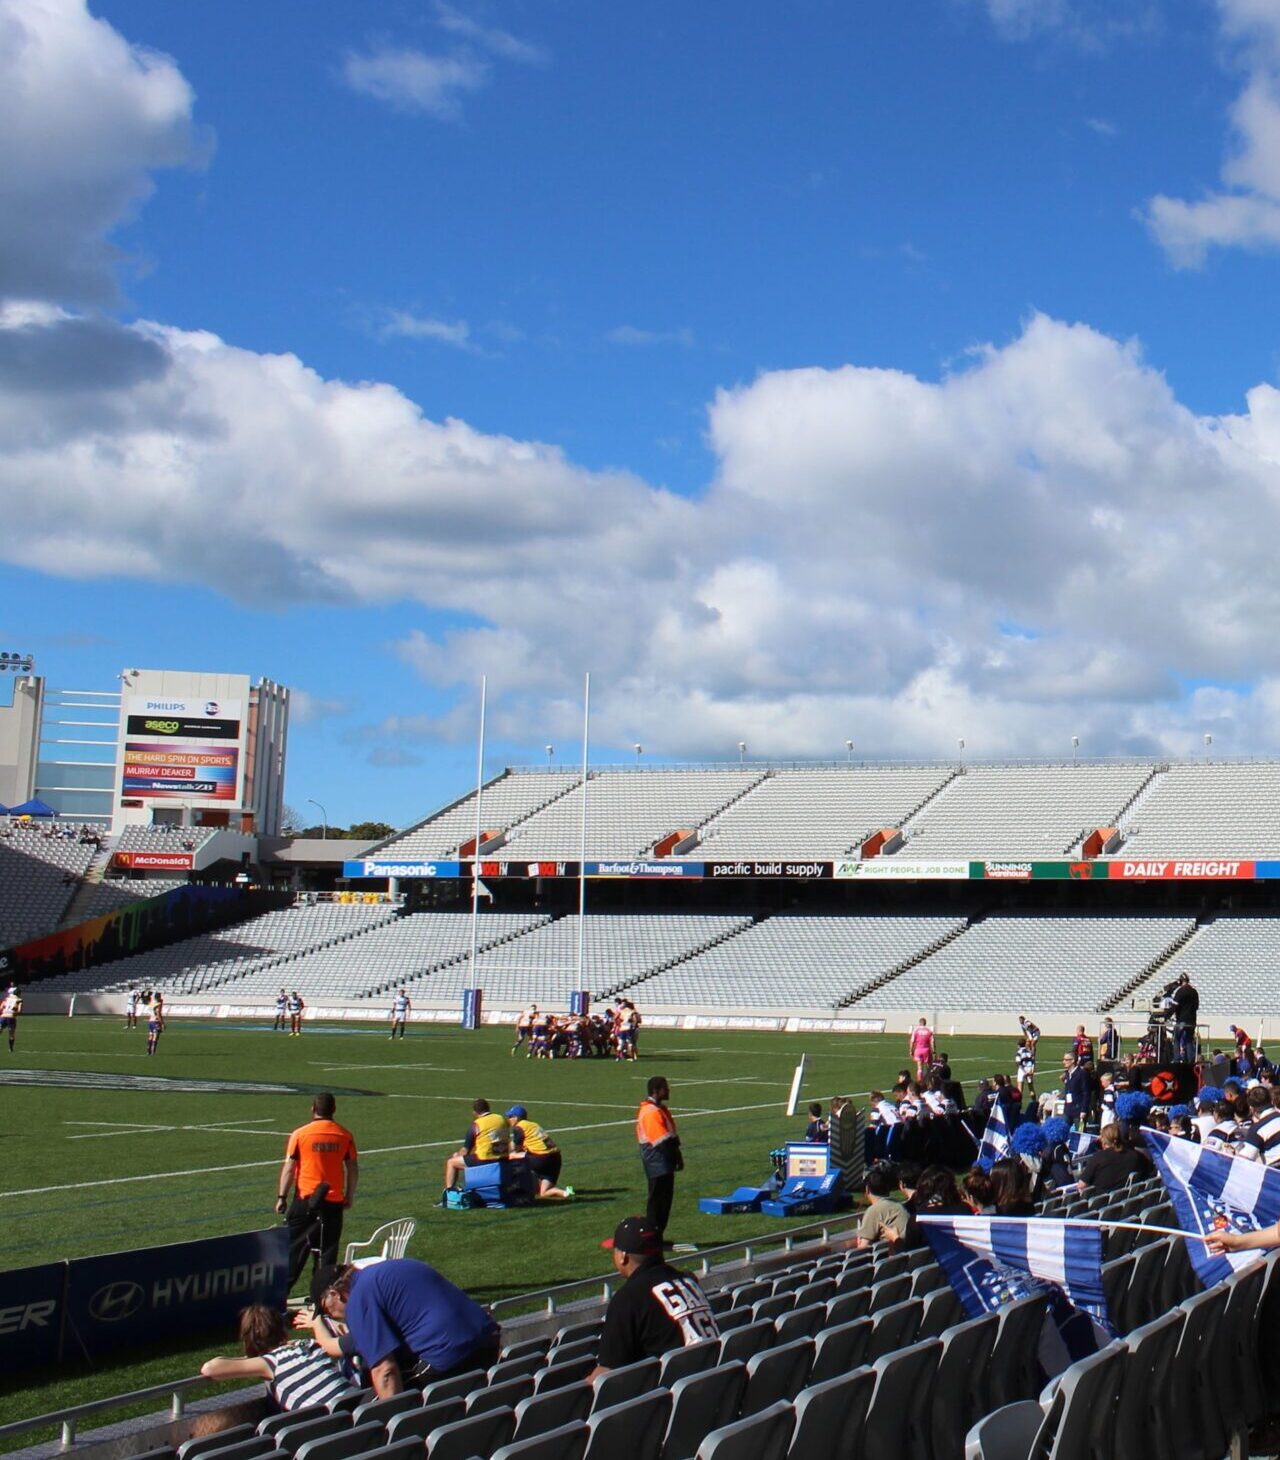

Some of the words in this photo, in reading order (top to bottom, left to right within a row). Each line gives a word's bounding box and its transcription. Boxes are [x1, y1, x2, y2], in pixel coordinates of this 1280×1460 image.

[146, 702, 186, 711] PHILIPS
[145, 720, 180, 733] aseco
[144, 754, 166, 762] HARD
[168, 755, 186, 763] SPIN
[188, 756, 199, 764] ON
[126, 766, 160, 775] MURRAY
[134, 857, 190, 865] McDonald's
[363, 862, 436, 876] Panasonic
[713, 862, 750, 876] pacific
[754, 862, 782, 875] build
[786, 863, 824, 877] supply
[925, 866, 942, 874] JOB
[985, 862, 1032, 872] BUNNINGS
[1123, 862, 1167, 876] DAILY
[1173, 862, 1240, 876] FREIGHT
[152, 1262, 274, 1308] HYUNDAI
